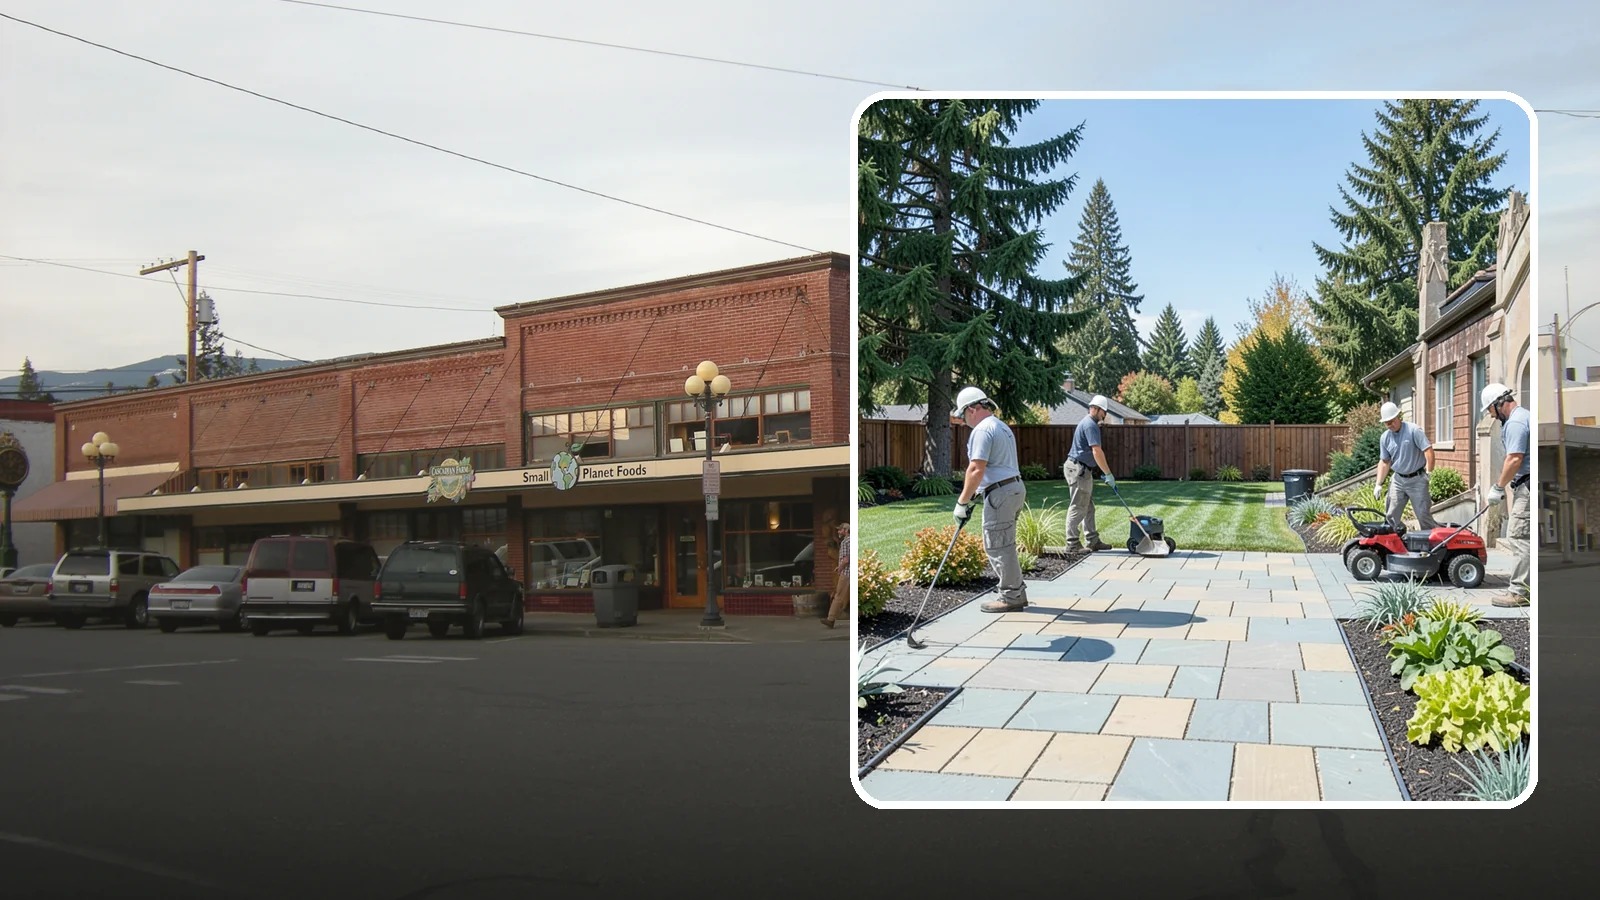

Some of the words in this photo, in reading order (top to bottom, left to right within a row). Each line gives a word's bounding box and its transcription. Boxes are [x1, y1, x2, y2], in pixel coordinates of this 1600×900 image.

[456, 465, 469, 474] FARM
[523, 471, 549, 483] Small
[582, 467, 614, 479] Planet
[616, 464, 647, 477] Foods
